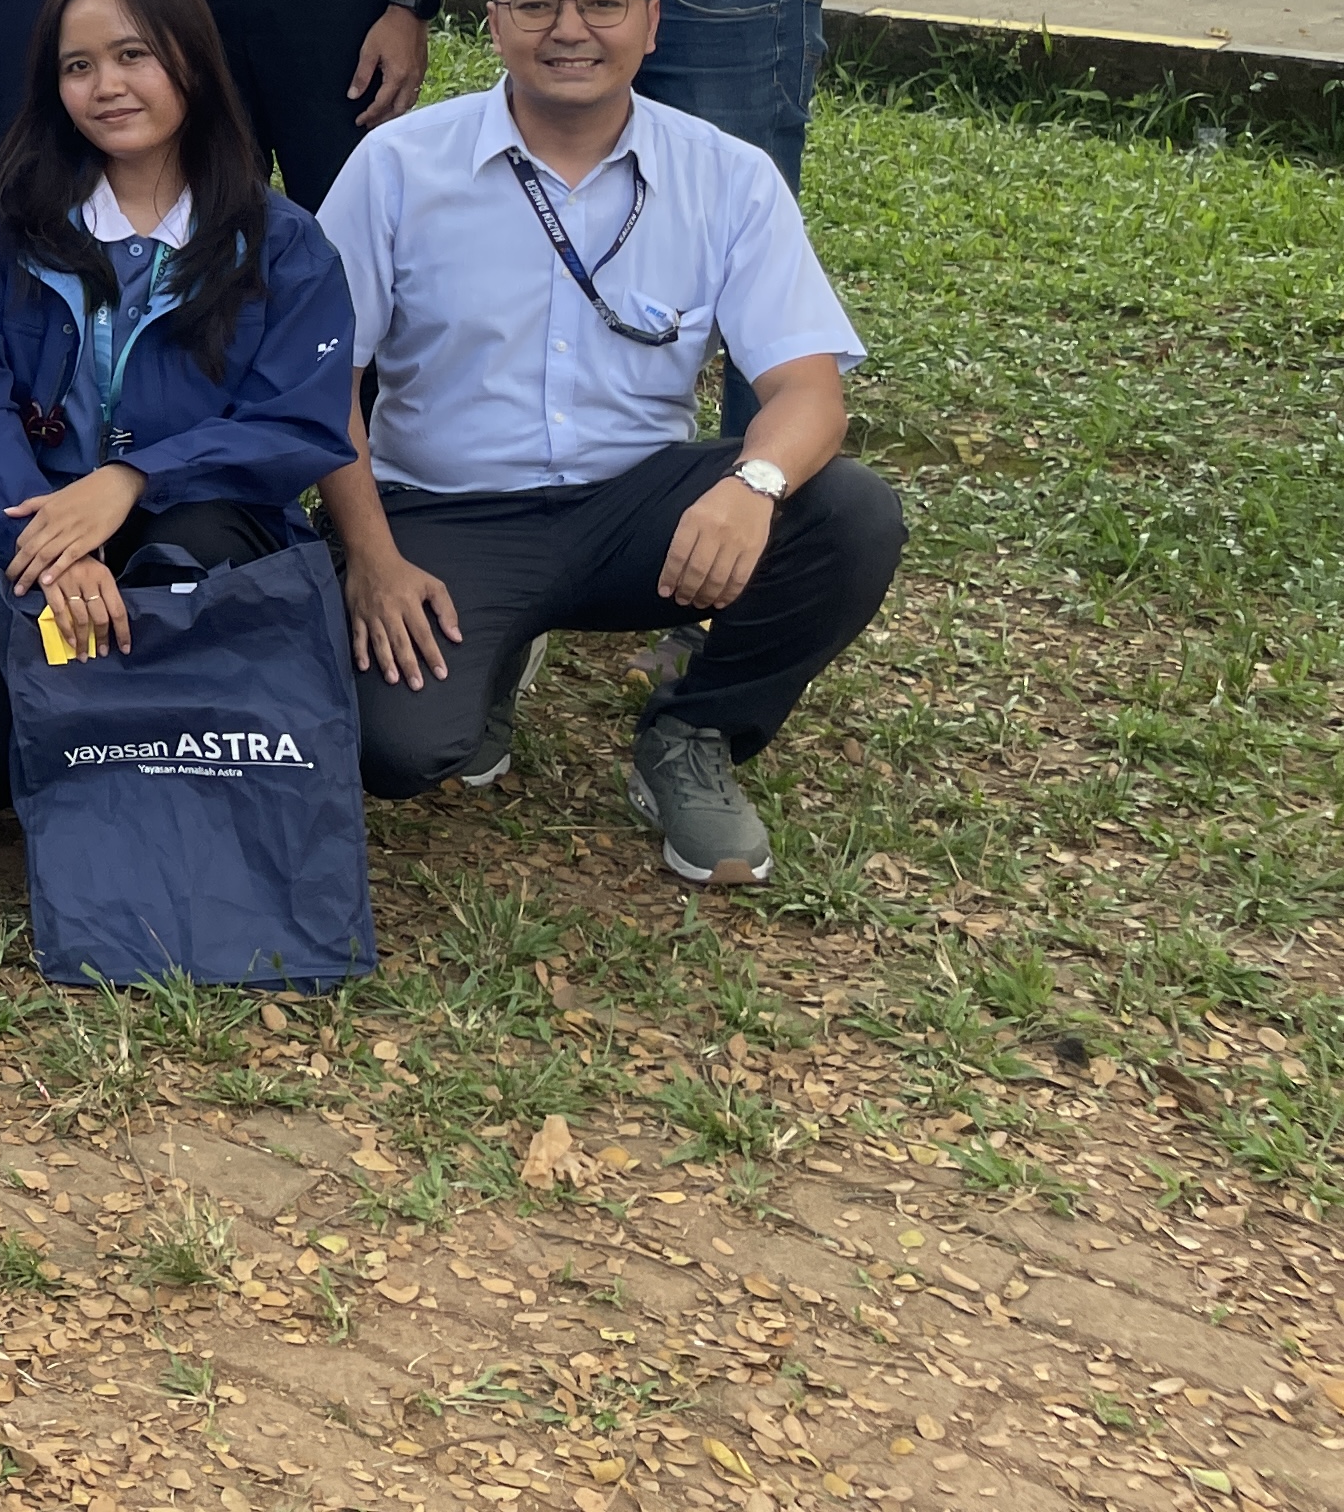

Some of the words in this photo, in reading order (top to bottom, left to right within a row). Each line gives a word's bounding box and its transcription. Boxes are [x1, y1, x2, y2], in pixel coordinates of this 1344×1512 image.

[525, 179, 549, 212] RANGER
[64, 740, 169, 767] yayasan
[175, 732, 303, 762] ASTRA
[138, 763, 176, 774] Yayasan
[178, 765, 216, 777] Amaliah
[217, 768, 243, 777] Astra
